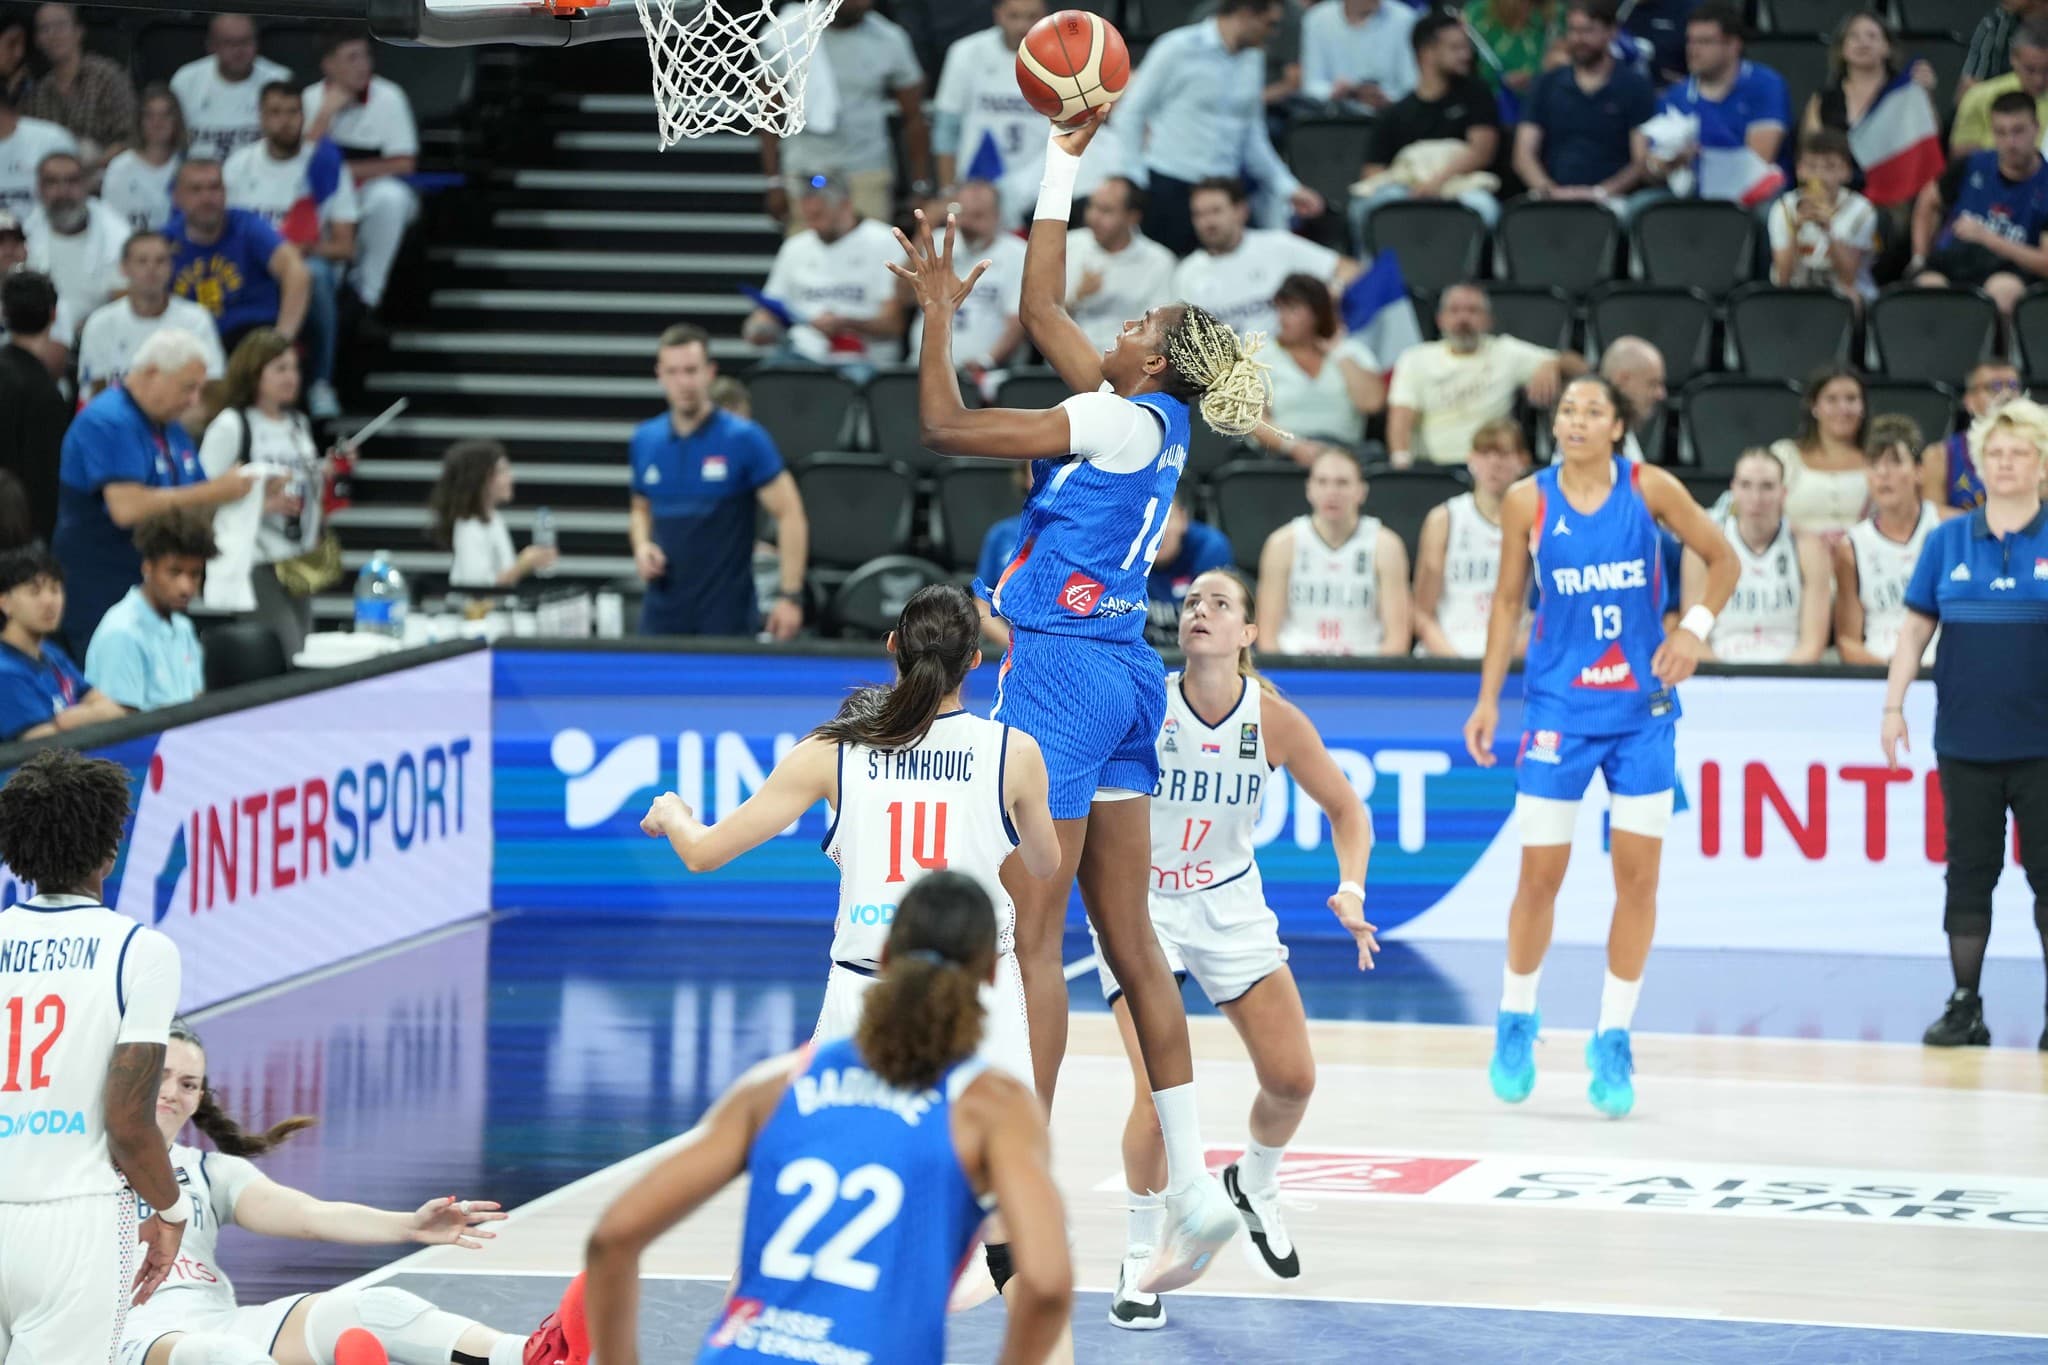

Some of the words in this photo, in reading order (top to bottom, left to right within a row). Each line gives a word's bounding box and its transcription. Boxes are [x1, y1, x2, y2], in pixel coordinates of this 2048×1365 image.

[1552, 558, 1647, 595] FRANCE
[1591, 604, 1622, 641] 13
[1580, 662, 1631, 685] MAIF
[868, 746, 974, 782] STANKOVIĆ
[1151, 768, 1261, 805] SRBIJA
[190, 736, 472, 916] INTERSPORT
[885, 802, 948, 883] 14
[1180, 818, 1212, 852] 17
[1151, 860, 1214, 891] mts
[0, 993, 66, 1092] 12
[1518, 1170, 2012, 1204] CAISSE
[759, 1156, 905, 1292] 22
